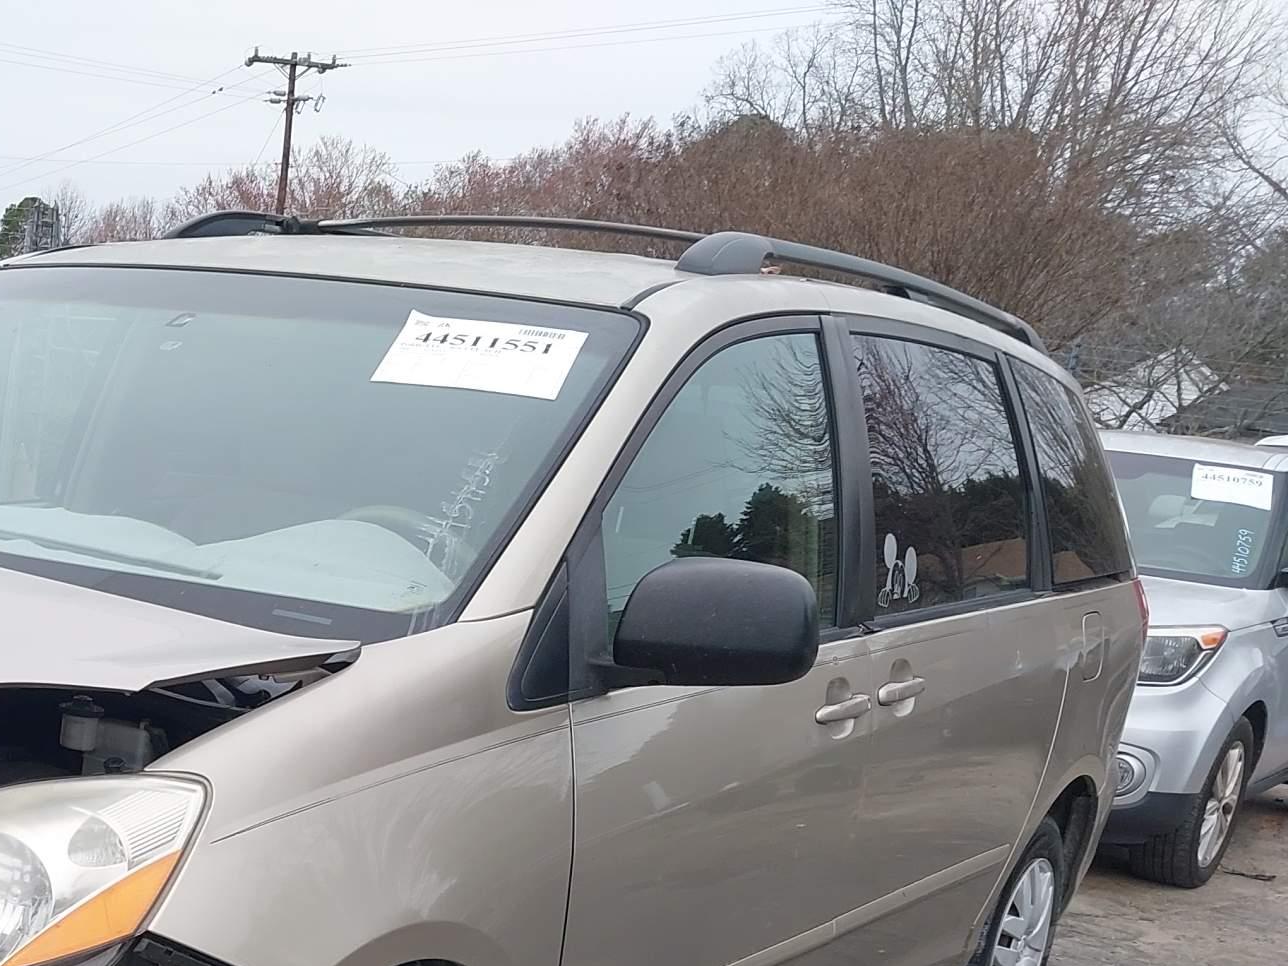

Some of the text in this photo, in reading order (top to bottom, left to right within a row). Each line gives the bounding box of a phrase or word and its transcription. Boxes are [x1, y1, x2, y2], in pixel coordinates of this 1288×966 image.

[416, 331, 553, 355] 44511551
[1201, 473, 1263, 487] 44510759
[1232, 529, 1254, 575] 44510759
